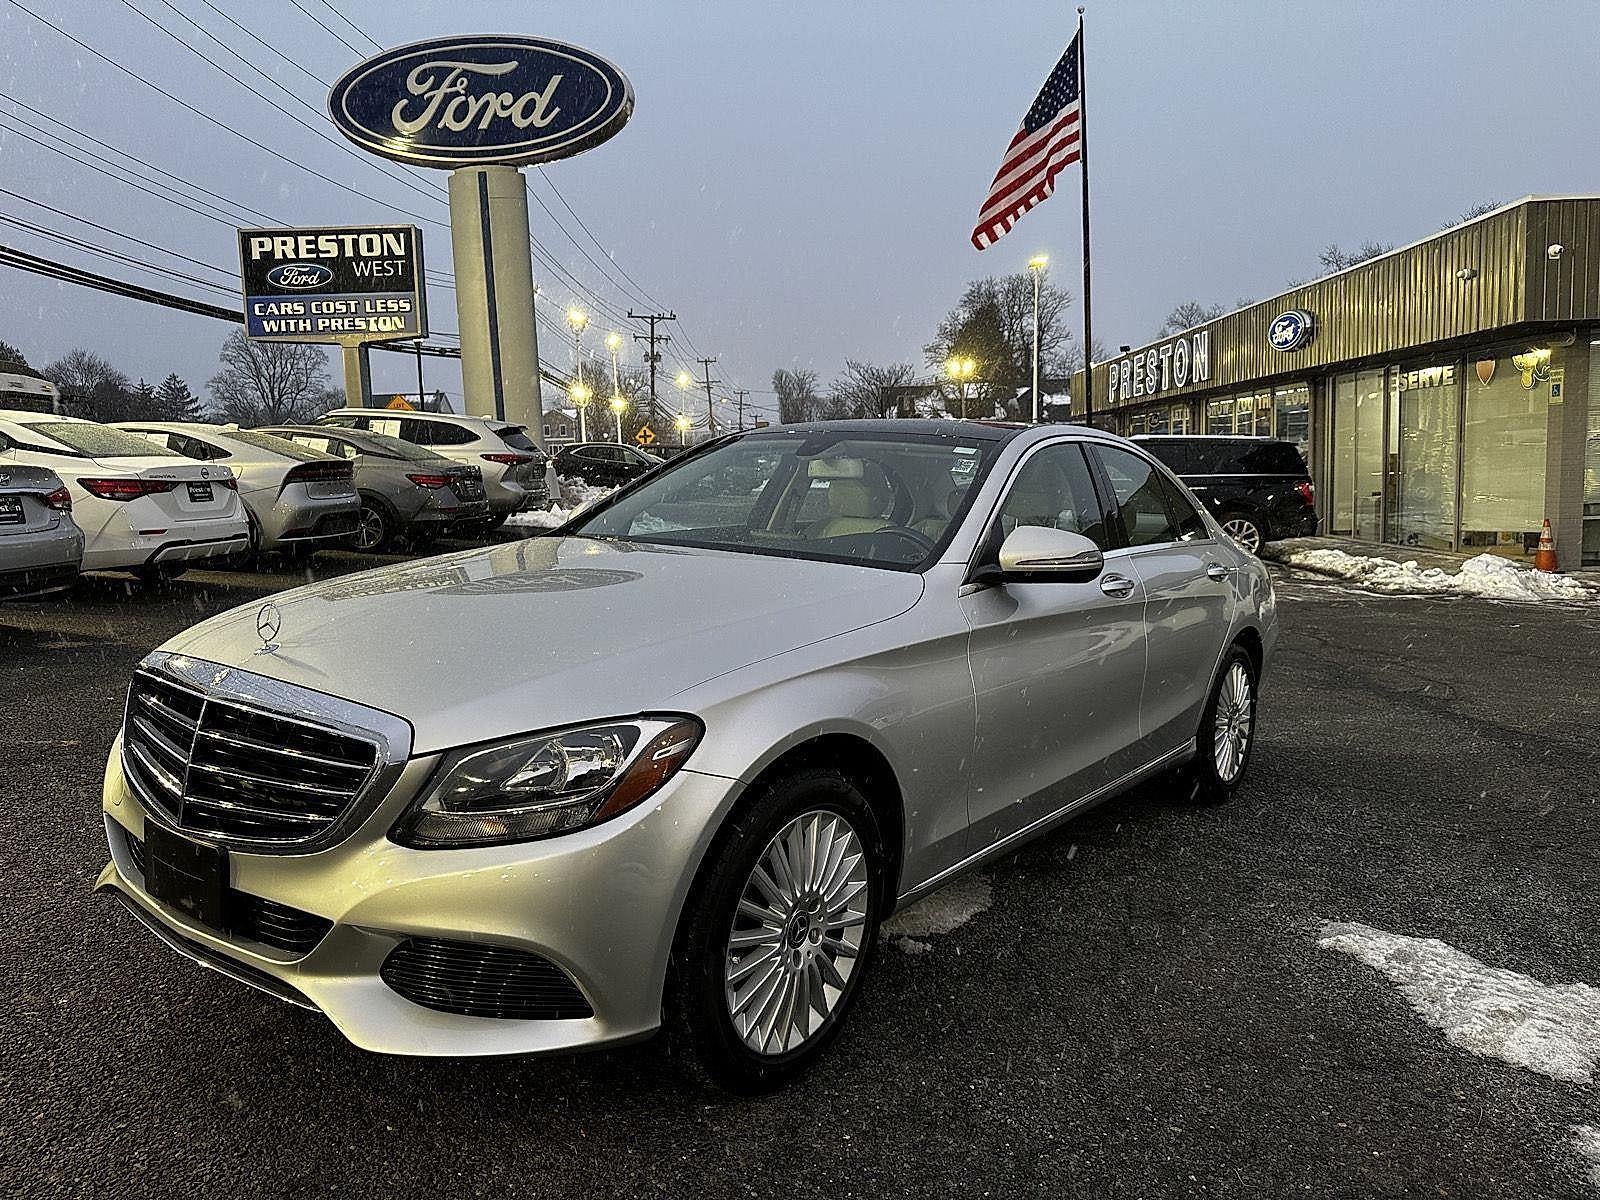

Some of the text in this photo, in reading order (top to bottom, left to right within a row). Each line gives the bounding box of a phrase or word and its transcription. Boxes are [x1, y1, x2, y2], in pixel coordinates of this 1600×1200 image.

[391, 60, 563, 134] Ford
[250, 232, 406, 260] PRESTON
[279, 266, 320, 286] Ford
[352, 259, 406, 278] WEST
[254, 299, 411, 317] CARS COST LESS
[262, 316, 405, 334] WITH PRESTON
[1108, 330, 1210, 403] PRESTON
